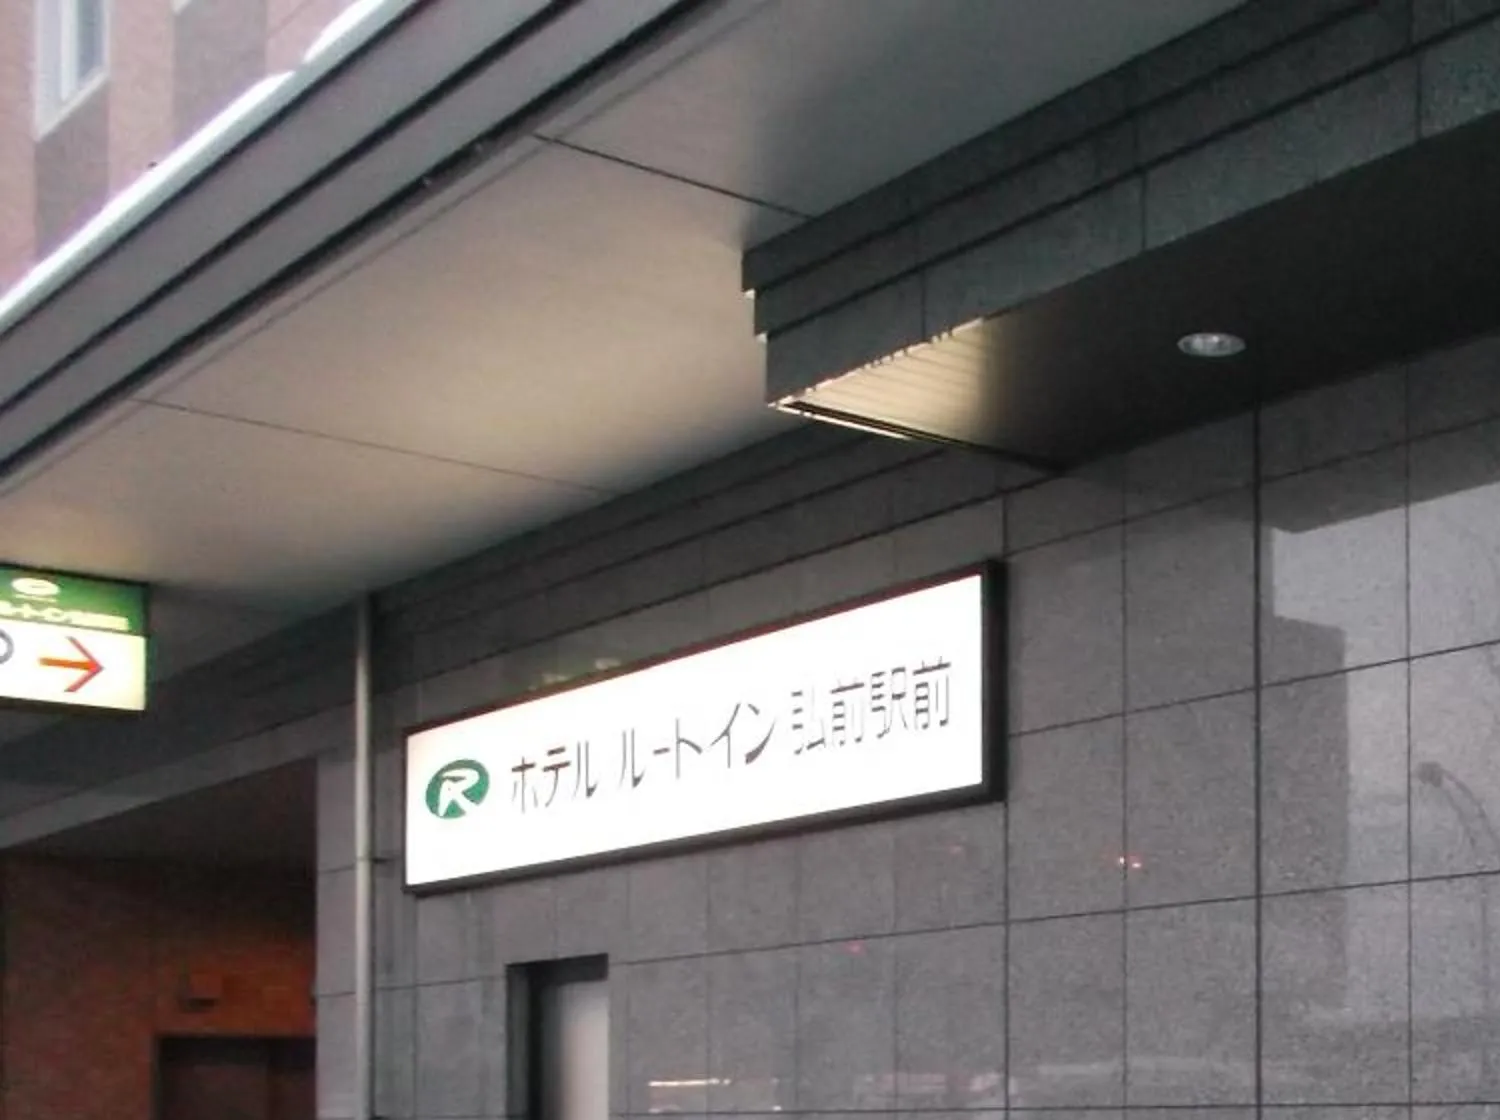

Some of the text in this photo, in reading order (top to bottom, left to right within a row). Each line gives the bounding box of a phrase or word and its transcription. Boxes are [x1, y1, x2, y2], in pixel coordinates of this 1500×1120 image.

[511, 656, 951, 813] ホテル ルートイン 弘前駅前
